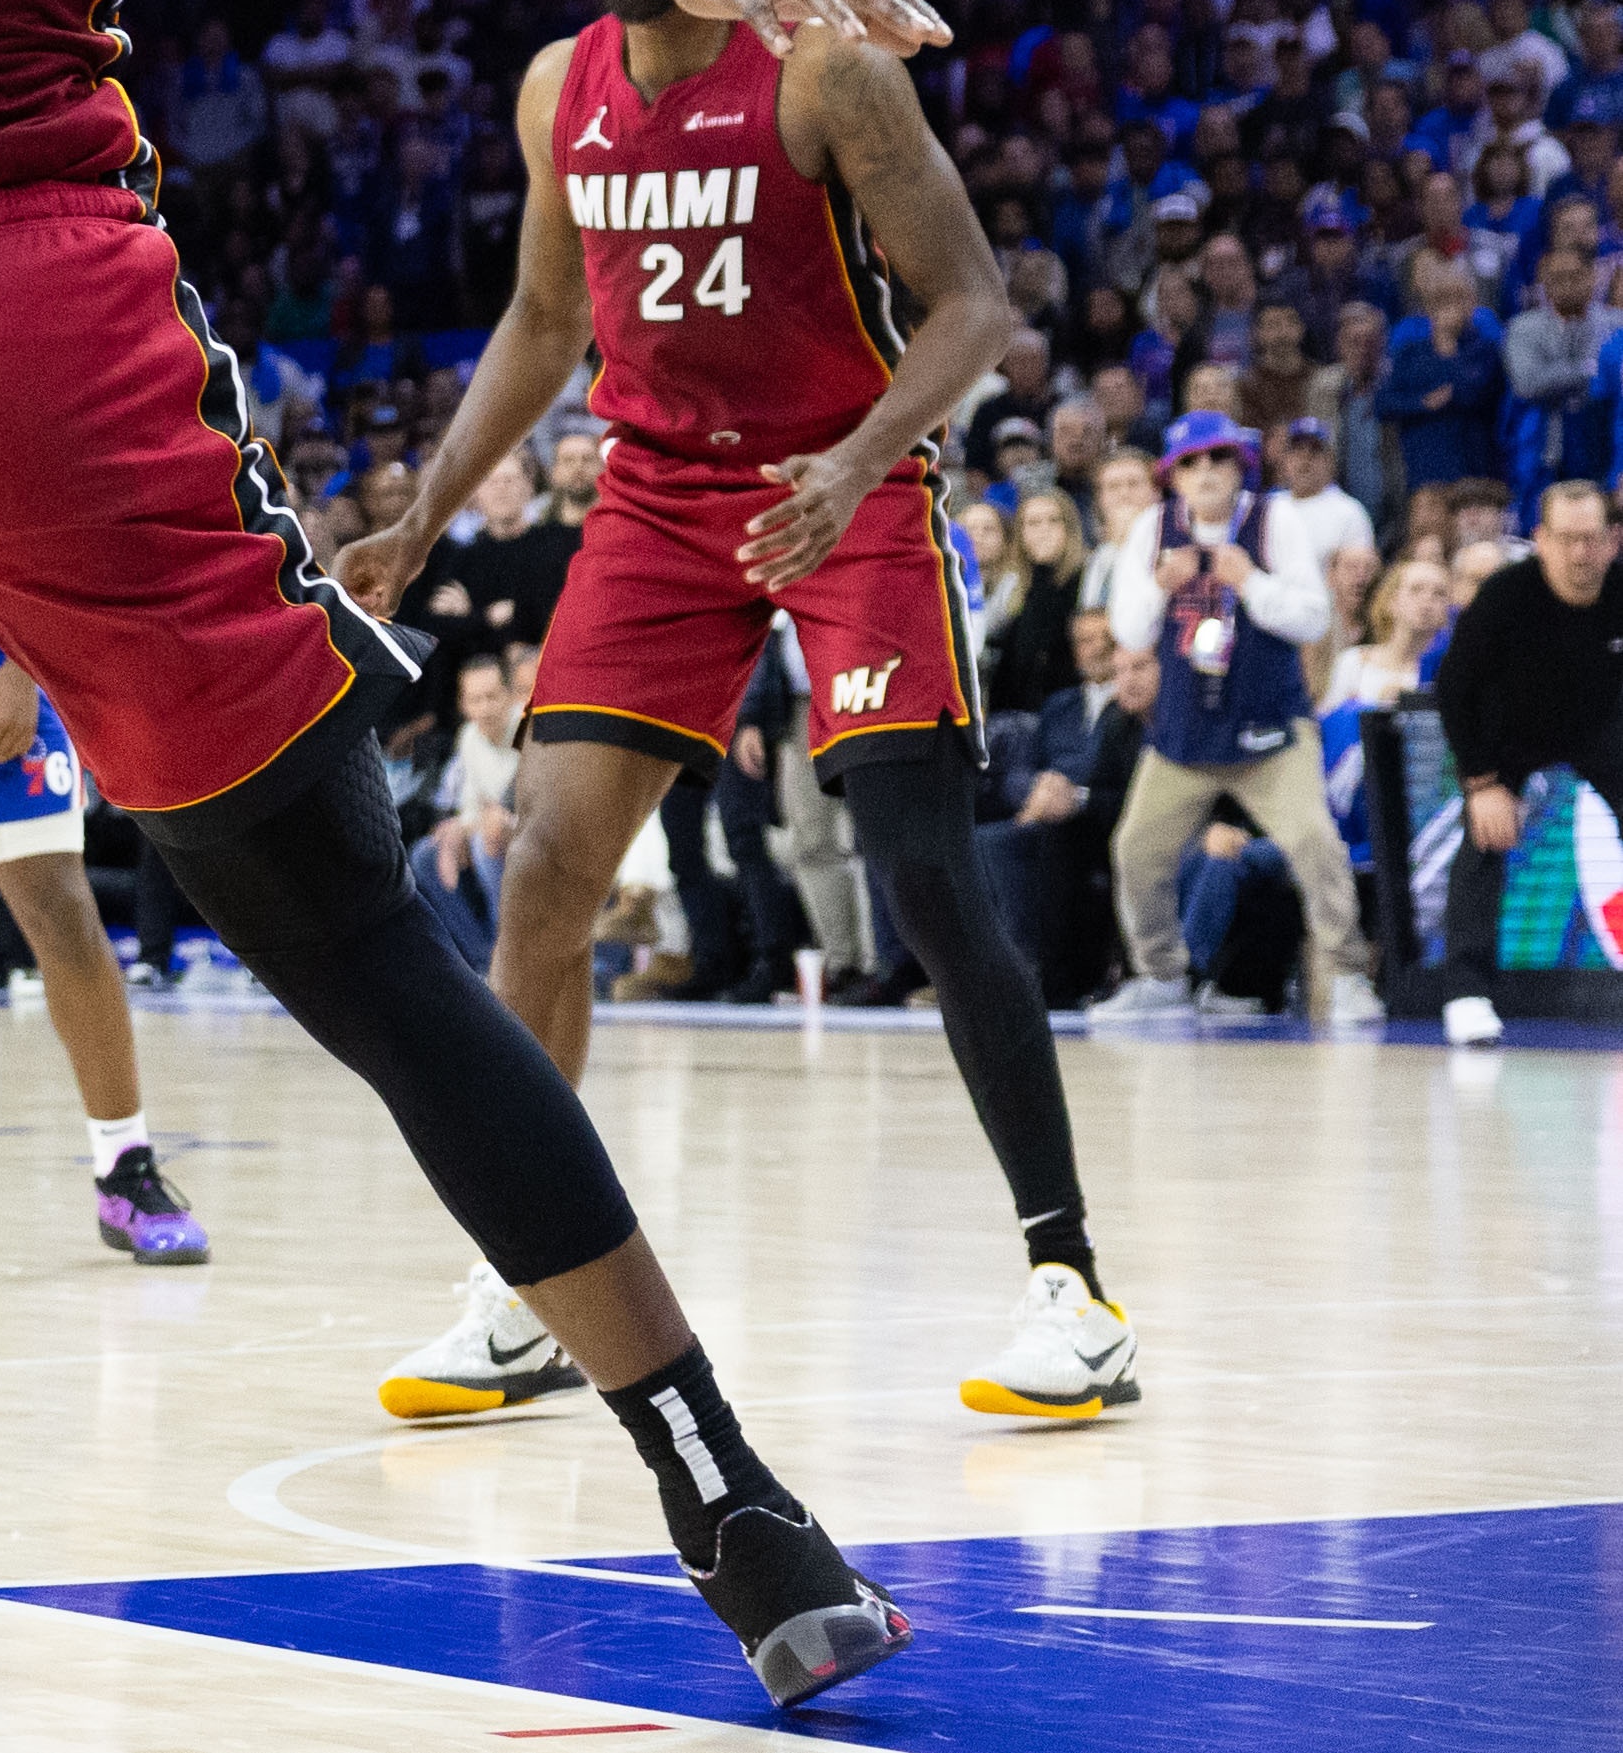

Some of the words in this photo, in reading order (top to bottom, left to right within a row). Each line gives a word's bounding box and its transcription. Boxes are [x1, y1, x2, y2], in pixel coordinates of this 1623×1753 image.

[566, 165, 760, 231] MIAMI
[638, 235, 752, 323] 24
[21, 750, 73, 797] 76
